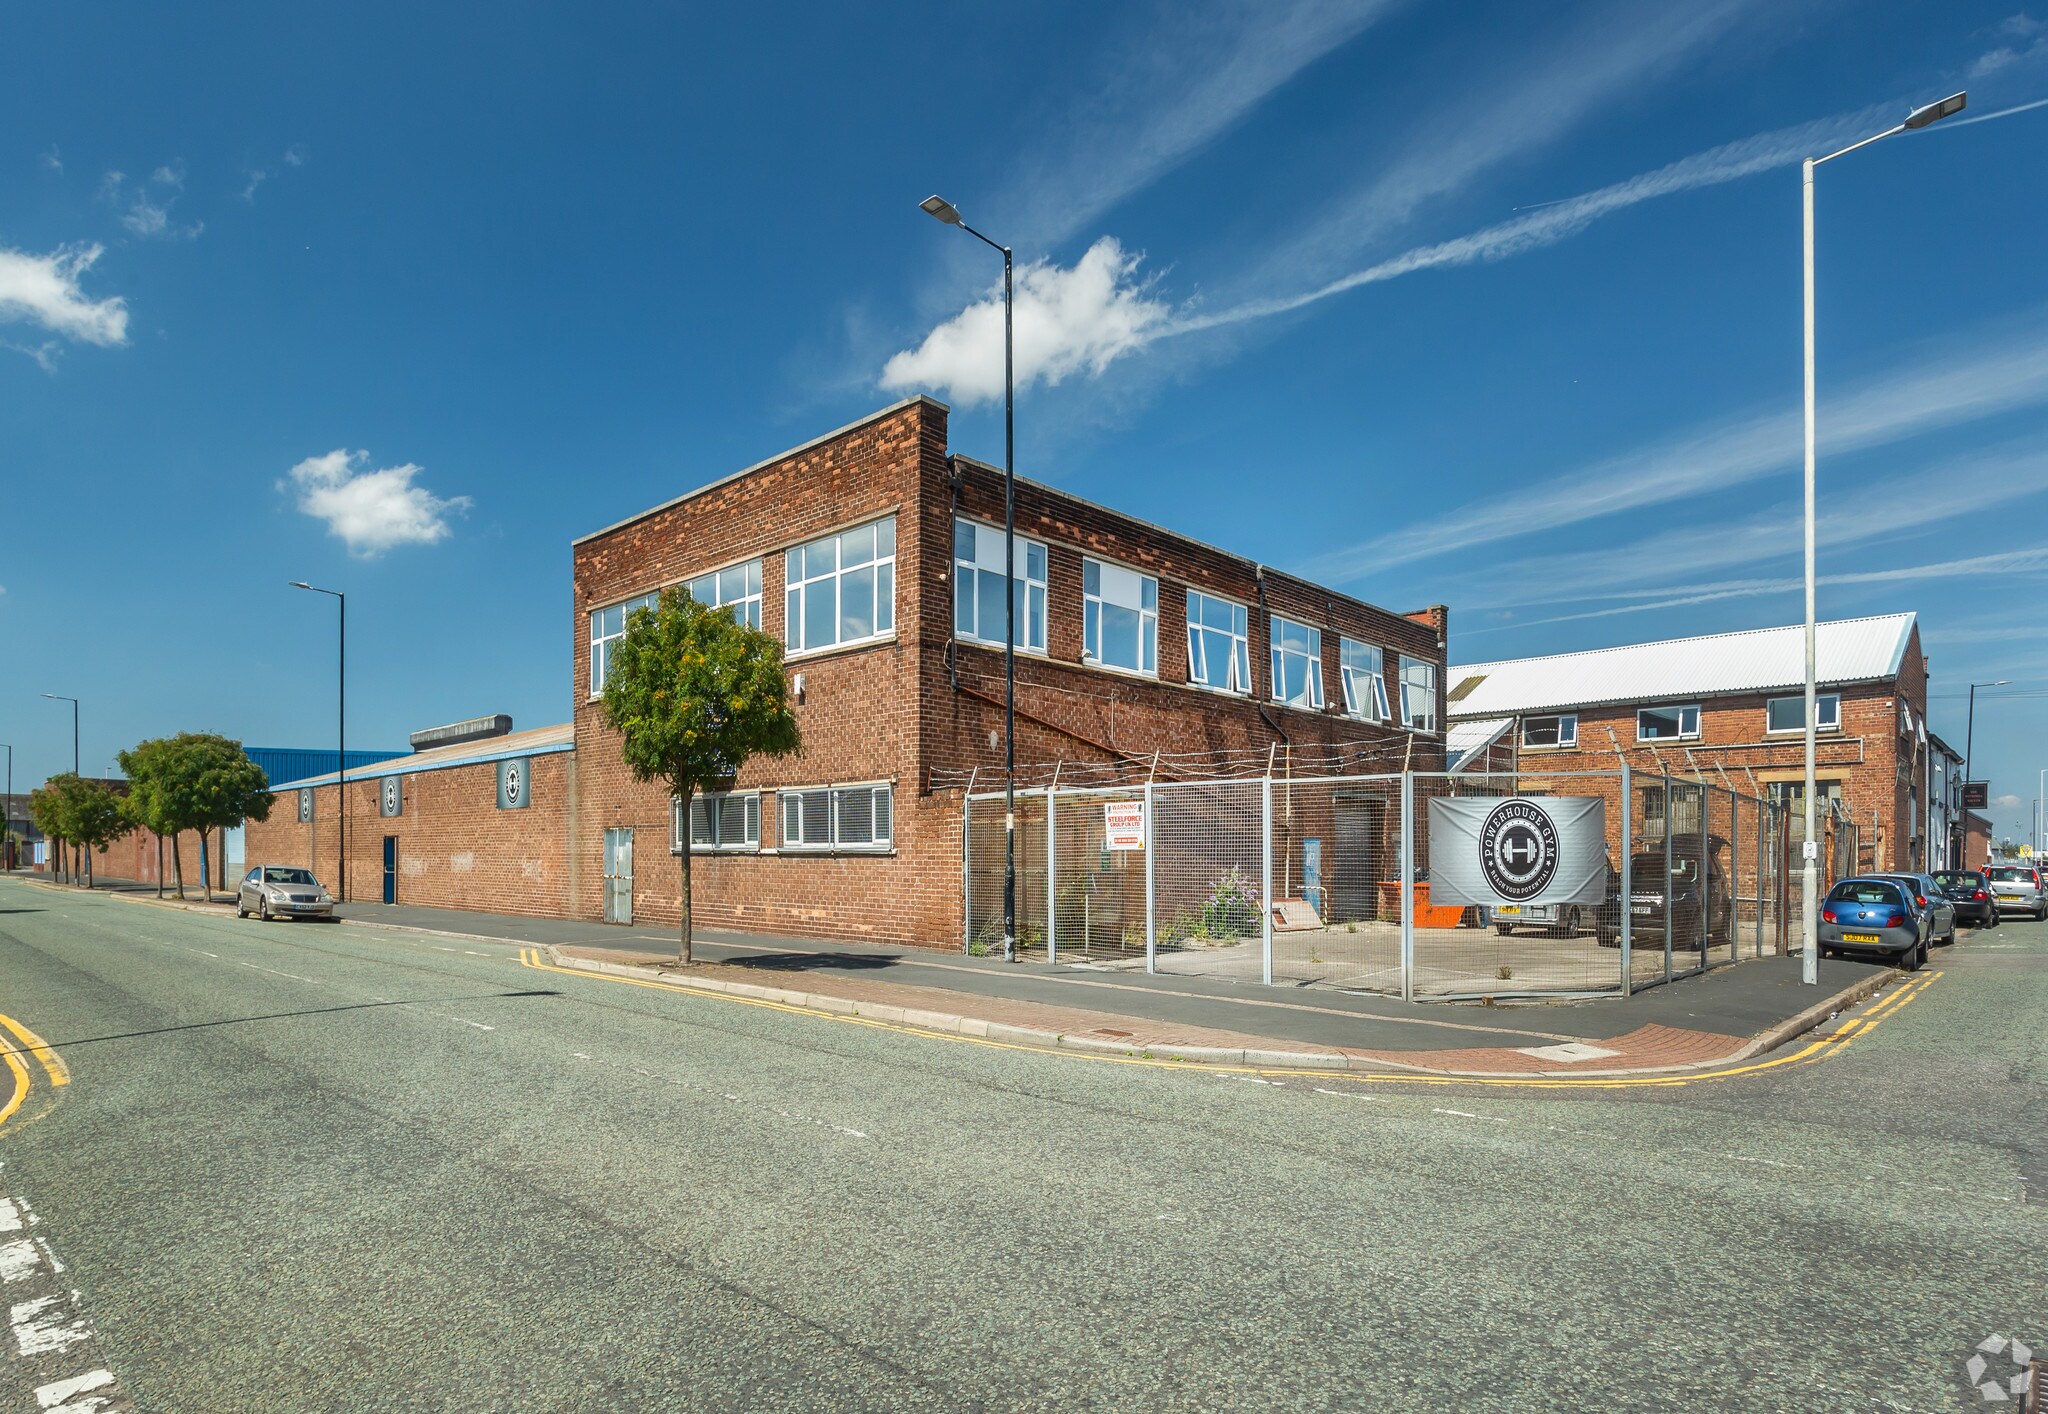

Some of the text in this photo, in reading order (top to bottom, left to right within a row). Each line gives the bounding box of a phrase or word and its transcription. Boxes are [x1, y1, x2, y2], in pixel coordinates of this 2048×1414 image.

[1485, 806, 1555, 858] POWERHOUSE GYM
[1490, 869, 1549, 894] REACH YOUR POTENTIAL
